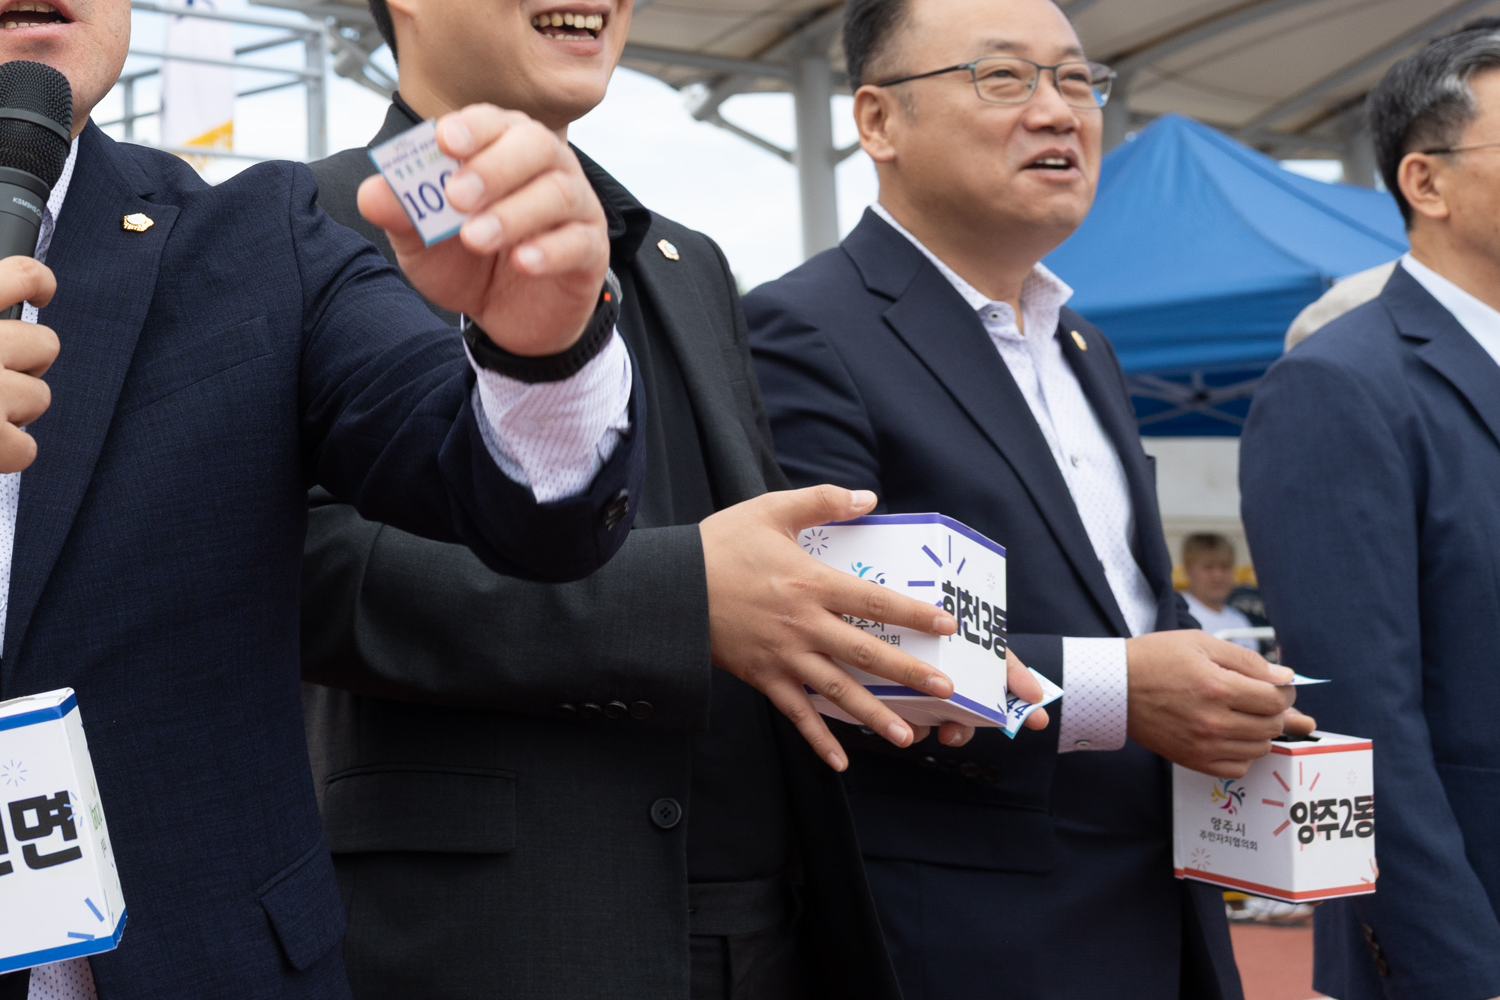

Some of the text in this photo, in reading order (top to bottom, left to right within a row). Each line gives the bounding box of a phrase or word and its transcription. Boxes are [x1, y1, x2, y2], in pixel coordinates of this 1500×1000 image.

[942, 580, 1007, 660] 회천3동
[1211, 816, 1246, 837] 양주시
[1290, 795, 1375, 844] 양주2동
[1199, 830, 1258, 852] 주민자치협의회
